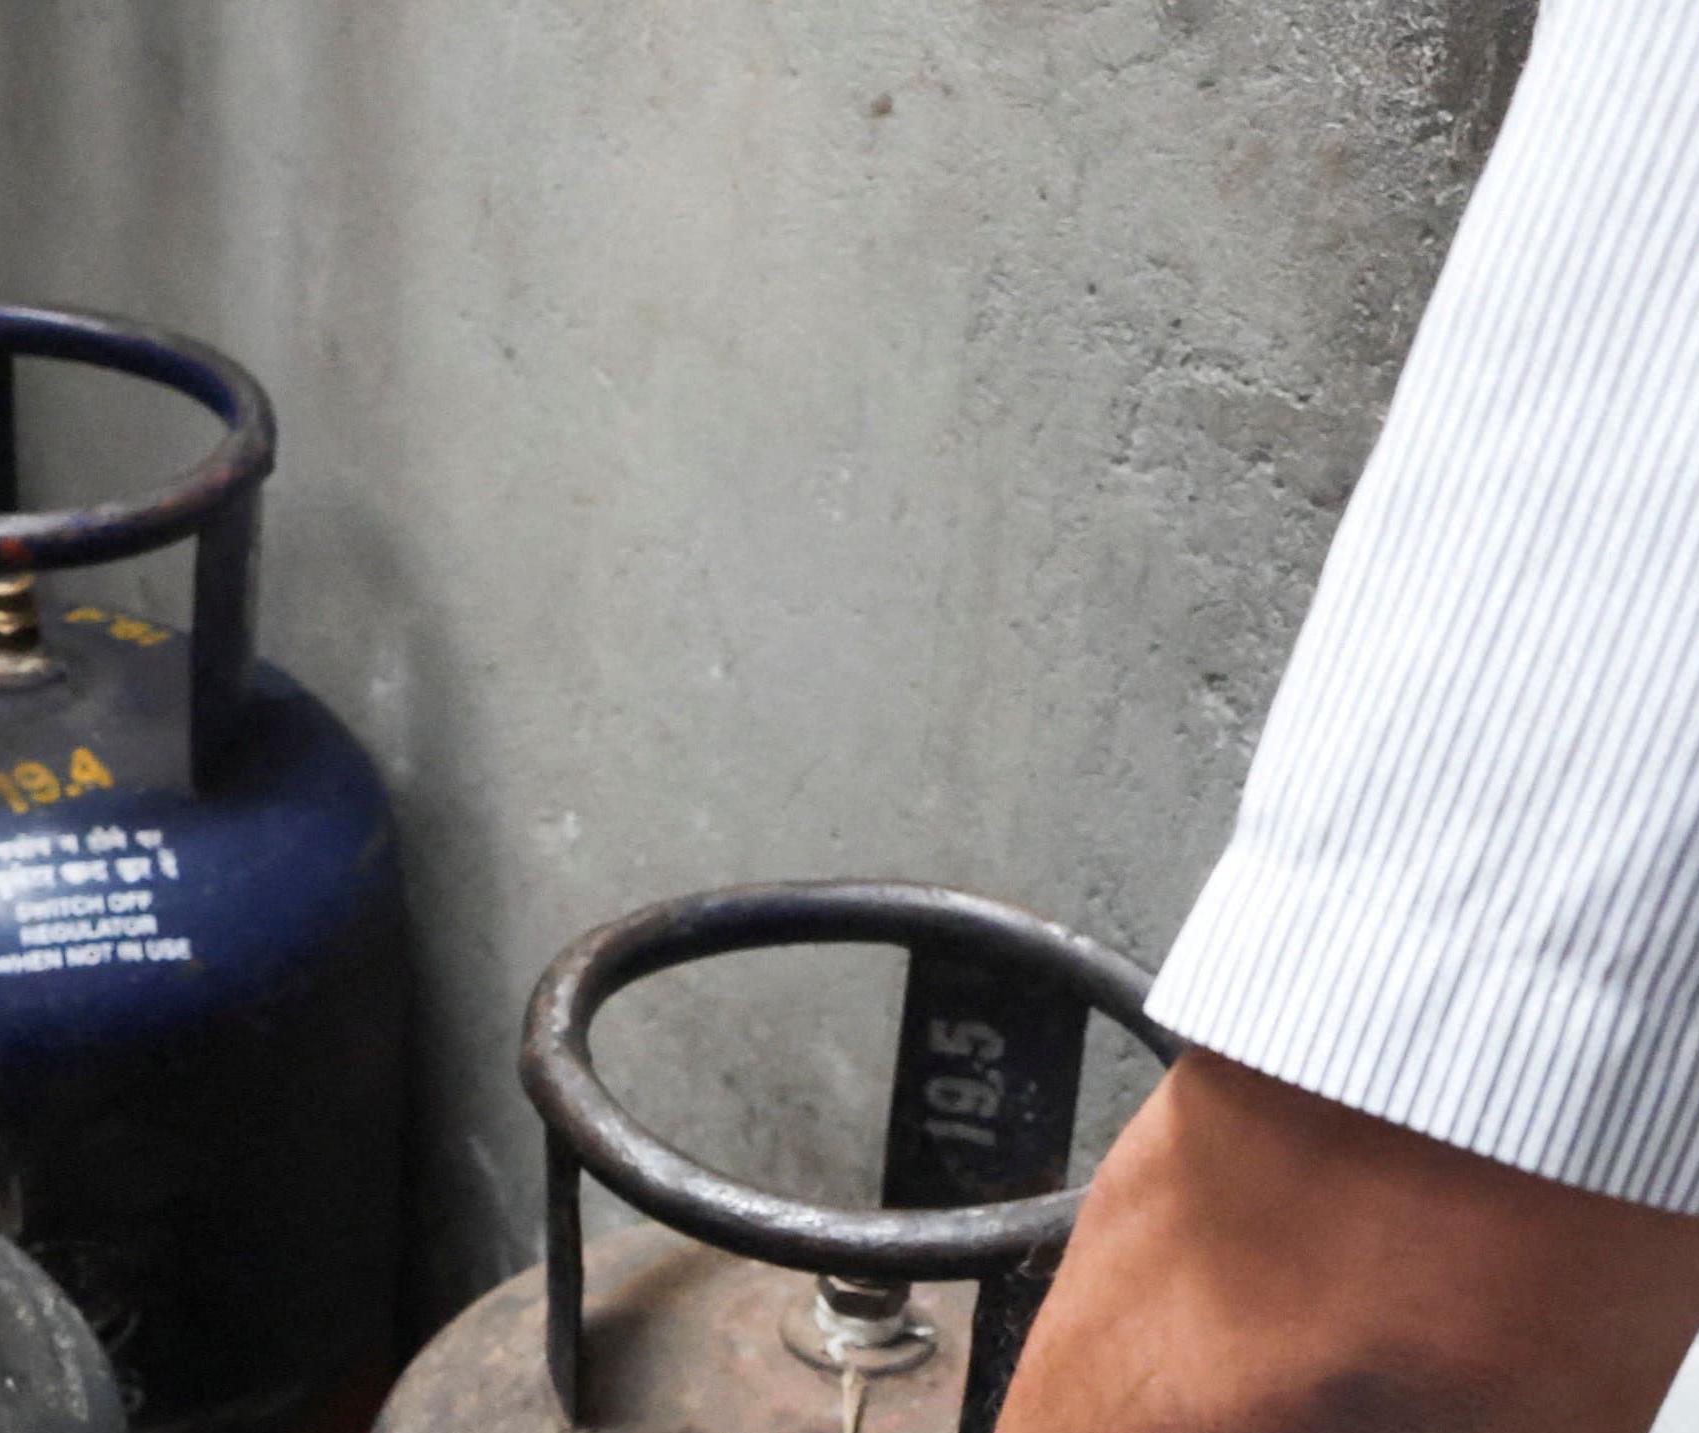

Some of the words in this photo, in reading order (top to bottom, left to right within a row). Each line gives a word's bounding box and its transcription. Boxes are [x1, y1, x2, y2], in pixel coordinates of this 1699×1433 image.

[15, 894, 104, 923] SWITCH
[107, 890, 152, 913] OFF
[19, 914, 157, 946] REGULATOR
[66, 942, 114, 967] NOT
[145, 938, 191, 961] USE
[923, 1018, 1005, 1147] 19.5
